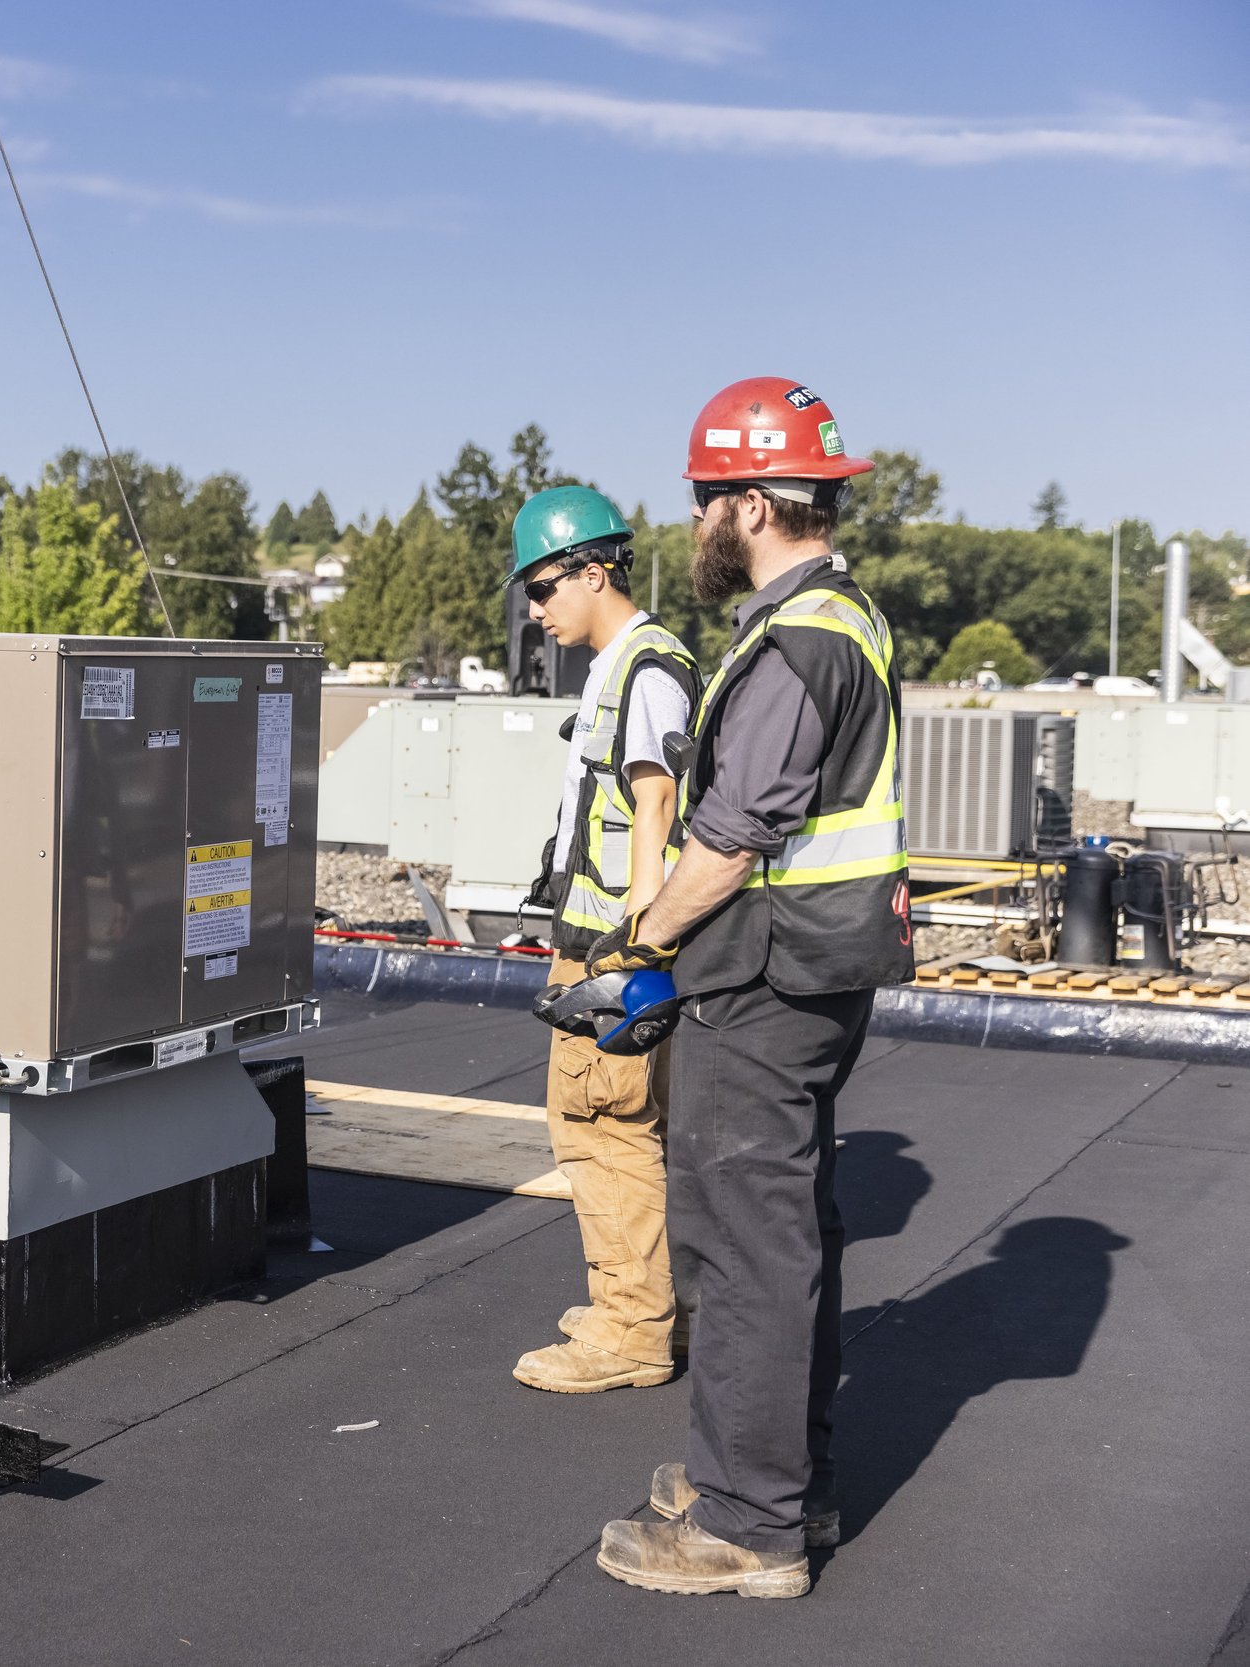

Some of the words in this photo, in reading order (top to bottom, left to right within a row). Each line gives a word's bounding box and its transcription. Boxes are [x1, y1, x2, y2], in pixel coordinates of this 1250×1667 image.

[788, 392, 809, 407] PR
[209, 845, 236, 859] CAUTION
[207, 861, 231, 870] INSTRUCTIONS
[210, 894, 234, 909] AVERTIR
[188, 911, 213, 921] INSTRUCTIONS
